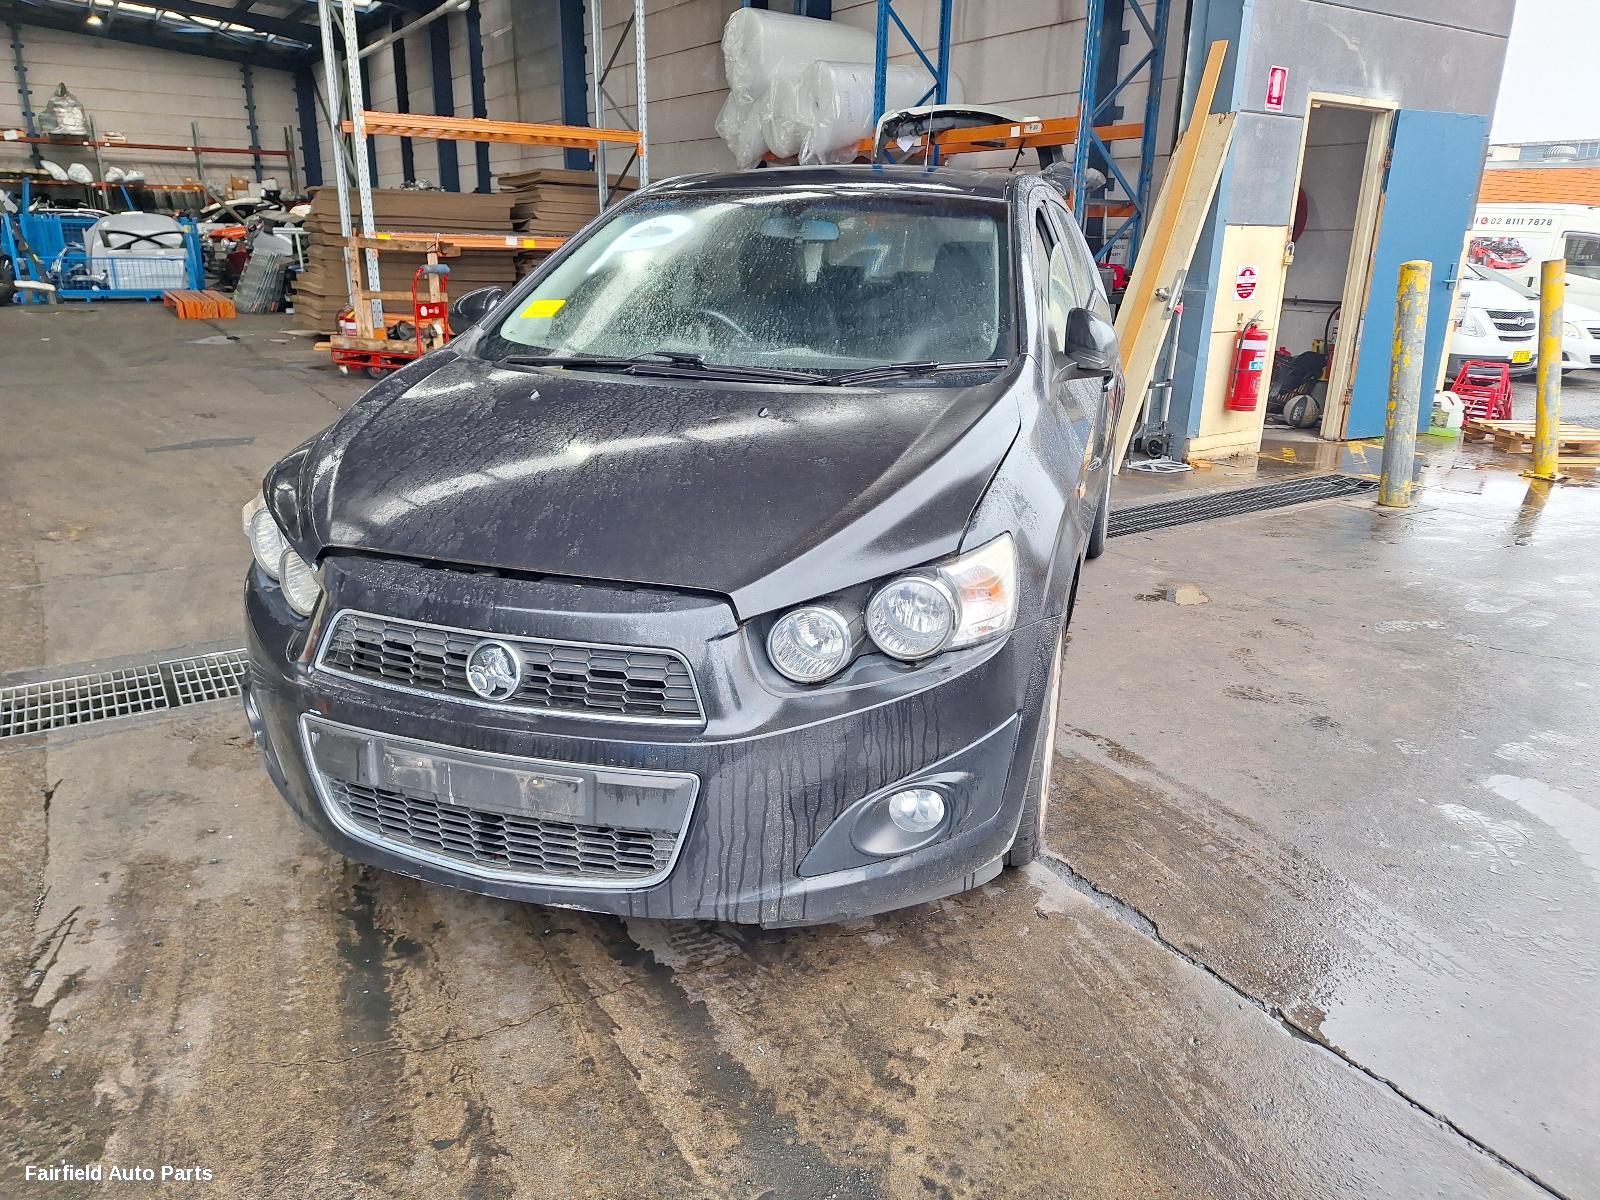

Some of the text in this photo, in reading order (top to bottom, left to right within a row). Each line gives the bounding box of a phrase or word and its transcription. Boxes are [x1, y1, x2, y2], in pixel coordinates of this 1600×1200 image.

[1490, 217, 1553, 226] 02 8111 7878
